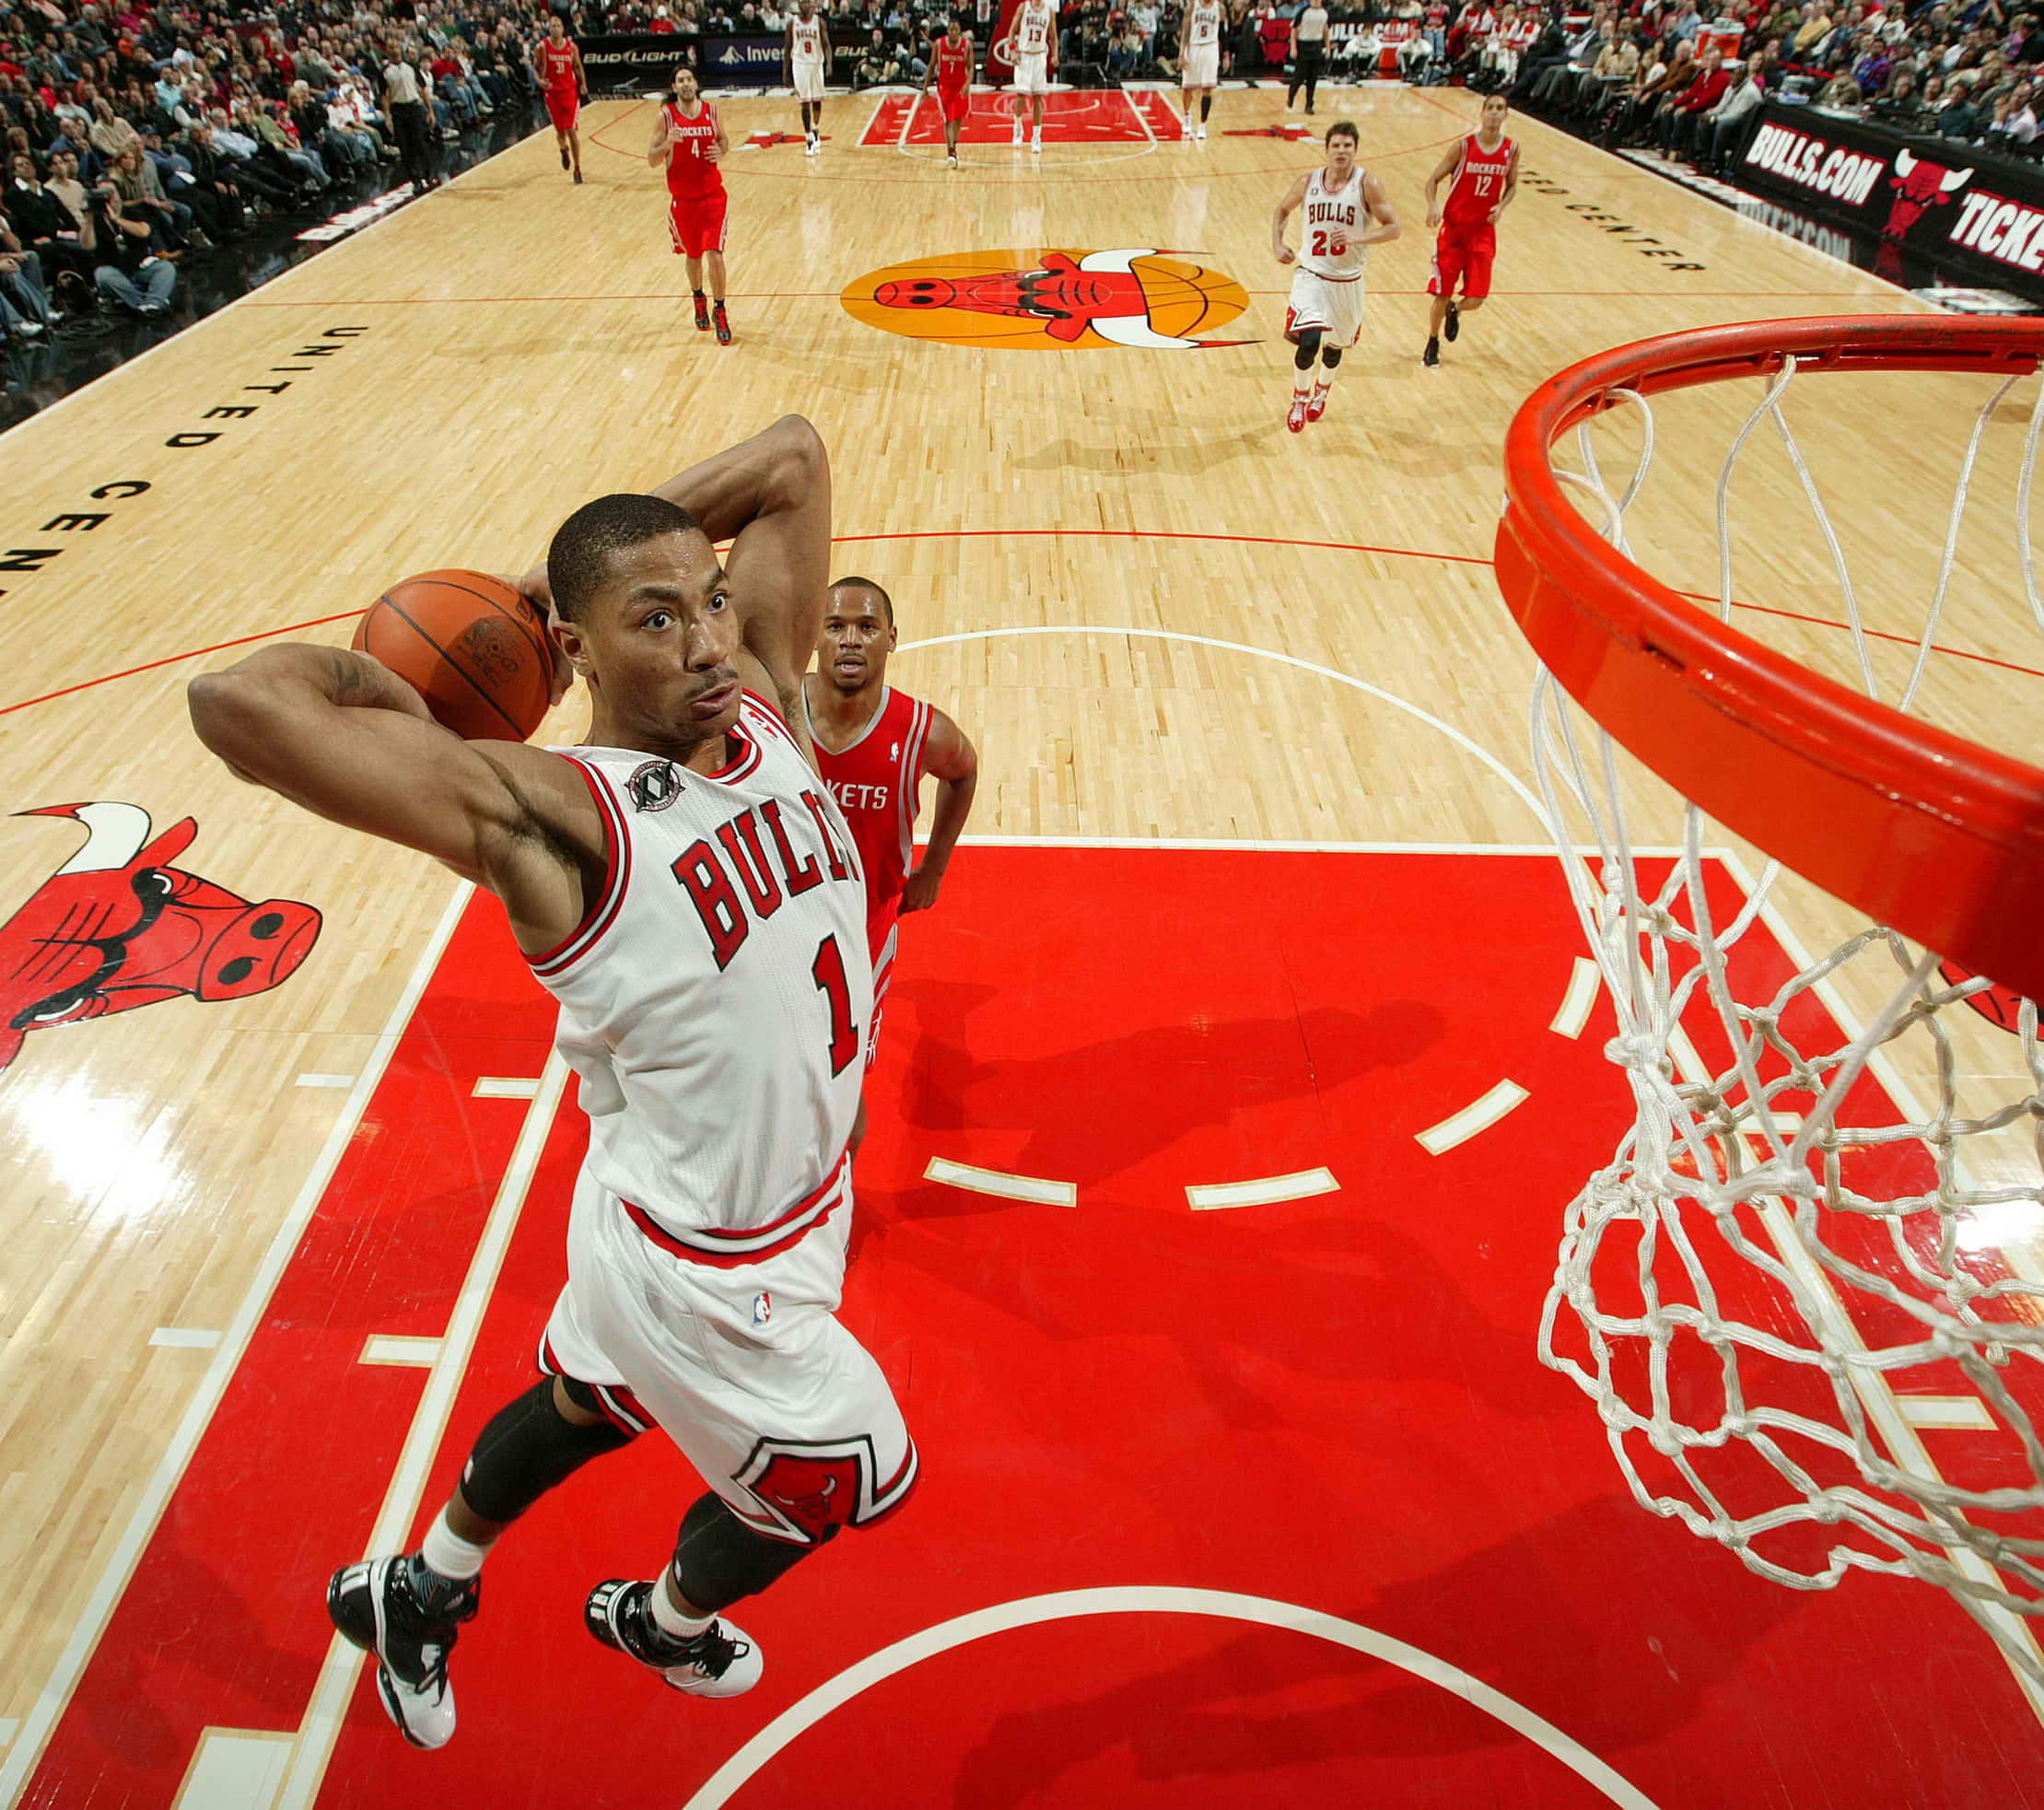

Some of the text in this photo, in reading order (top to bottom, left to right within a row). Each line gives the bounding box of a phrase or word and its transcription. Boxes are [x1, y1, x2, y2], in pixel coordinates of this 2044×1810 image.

[1028, 29, 1042, 42] 13
[583, 53, 622, 64] BUD
[631, 51, 684, 64] LIGHT
[691, 139, 700, 158] 4
[1744, 123, 1885, 205] BULLS.COM
[1474, 176, 1492, 196] 12
[1308, 202, 1356, 227] BULLS
[1948, 191, 2044, 274] TICKE
[0, 325, 369, 598] UNITED CEN
[825, 777, 889, 811] KETS
[670, 788, 860, 974] BULL
[811, 931, 859, 1080] 1
